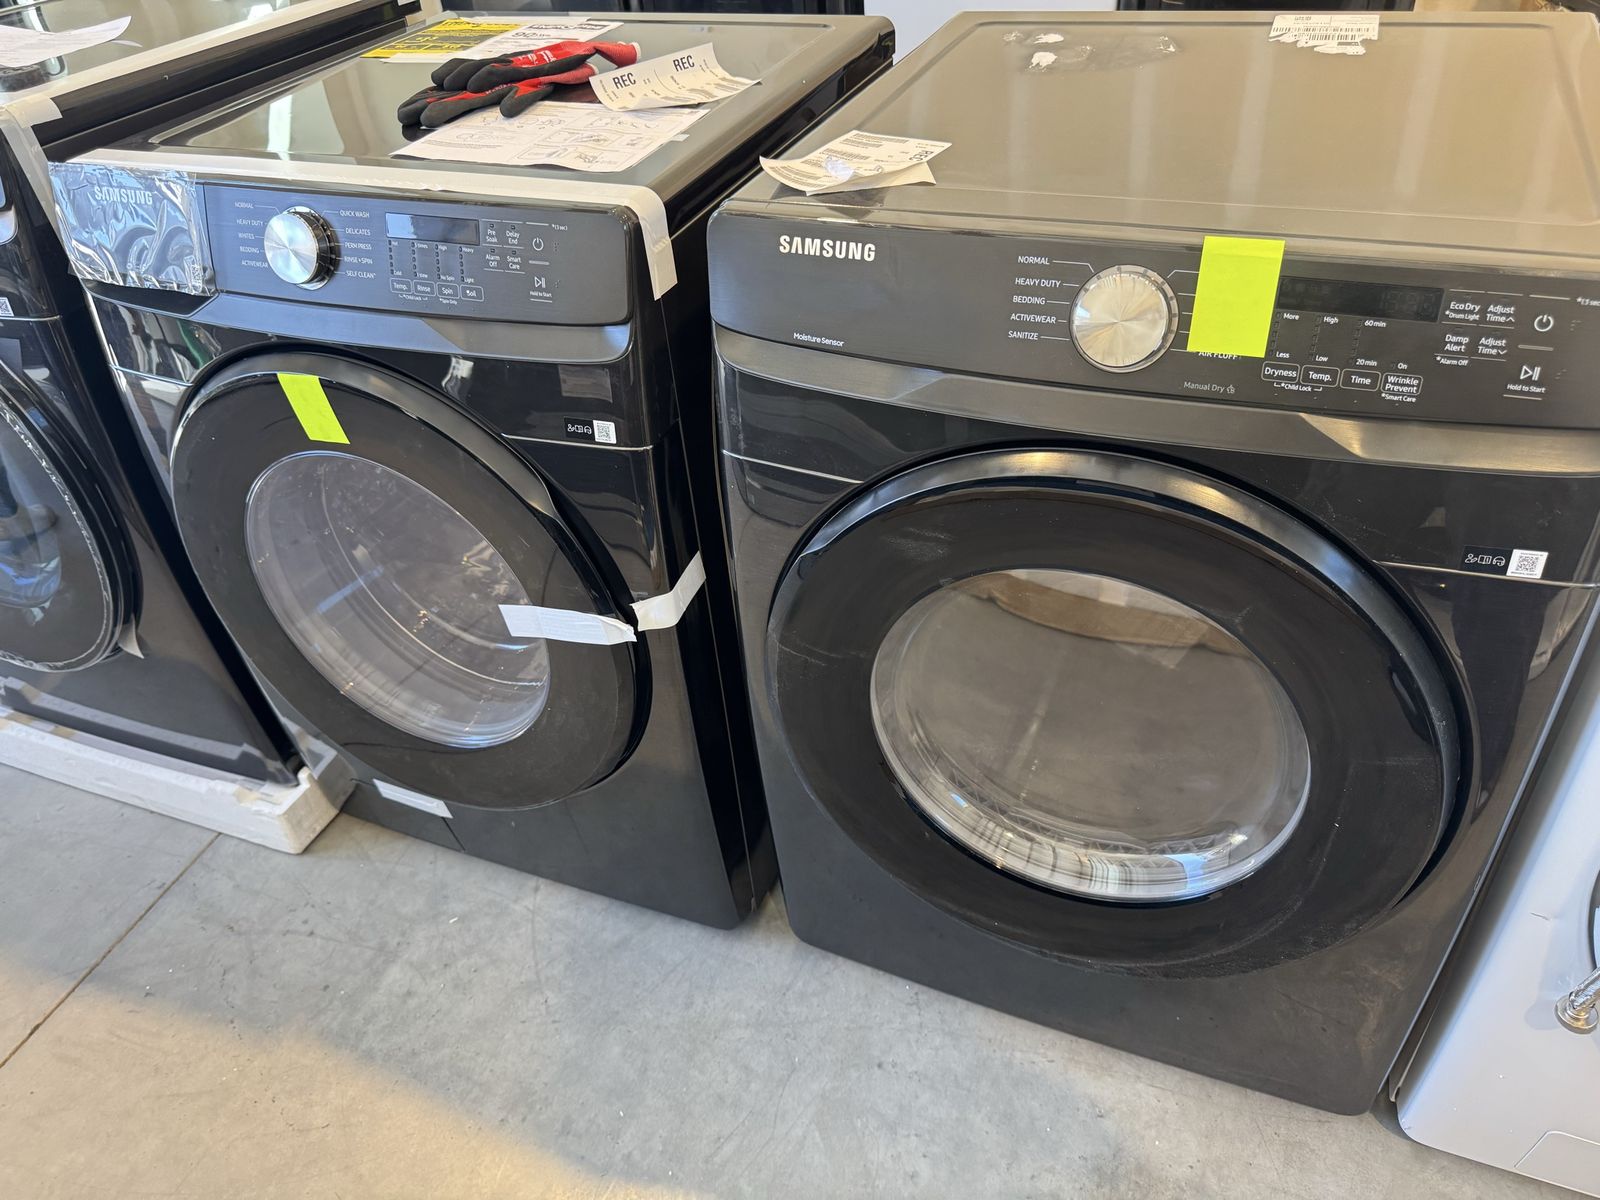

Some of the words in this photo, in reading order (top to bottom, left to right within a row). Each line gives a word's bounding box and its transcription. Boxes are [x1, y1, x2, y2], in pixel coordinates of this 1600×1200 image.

[672, 54, 696, 72] REC
[612, 72, 637, 90] REC
[94, 186, 153, 205] SAMSUNG
[779, 234, 876, 262] SAMSUNG
[1018, 255, 1050, 265] NORMAL
[1015, 278, 1040, 286] HEAVY
[1041, 279, 1061, 288] DUTY
[1013, 295, 1046, 305] BEDDING
[1450, 302, 1464, 310] Eco
[1465, 303, 1481, 313] Dry
[1488, 305, 1515, 315] Adjust
[1010, 313, 1056, 324] ACTIVEWEAR
[1466, 312, 1480, 321] Light
[1486, 314, 1506, 322] Time
[793, 332, 821, 343] Moisture
[822, 337, 844, 346] Sensor
[1008, 331, 1038, 340] SANITIZE
[1445, 334, 1469, 344] Damp
[1479, 337, 1506, 347] Adjust
[1444, 343, 1466, 353] Alert
[1478, 346, 1497, 355] Time
[1264, 366, 1297, 377] Dryness
[1308, 371, 1332, 382] Temp.
[1351, 375, 1371, 385] Time
[1388, 375, 1418, 385] Wrinkle
[1184, 381, 1210, 390] Manual
[1211, 384, 1224, 393] Dry
[1385, 383, 1417, 393] Prevent
